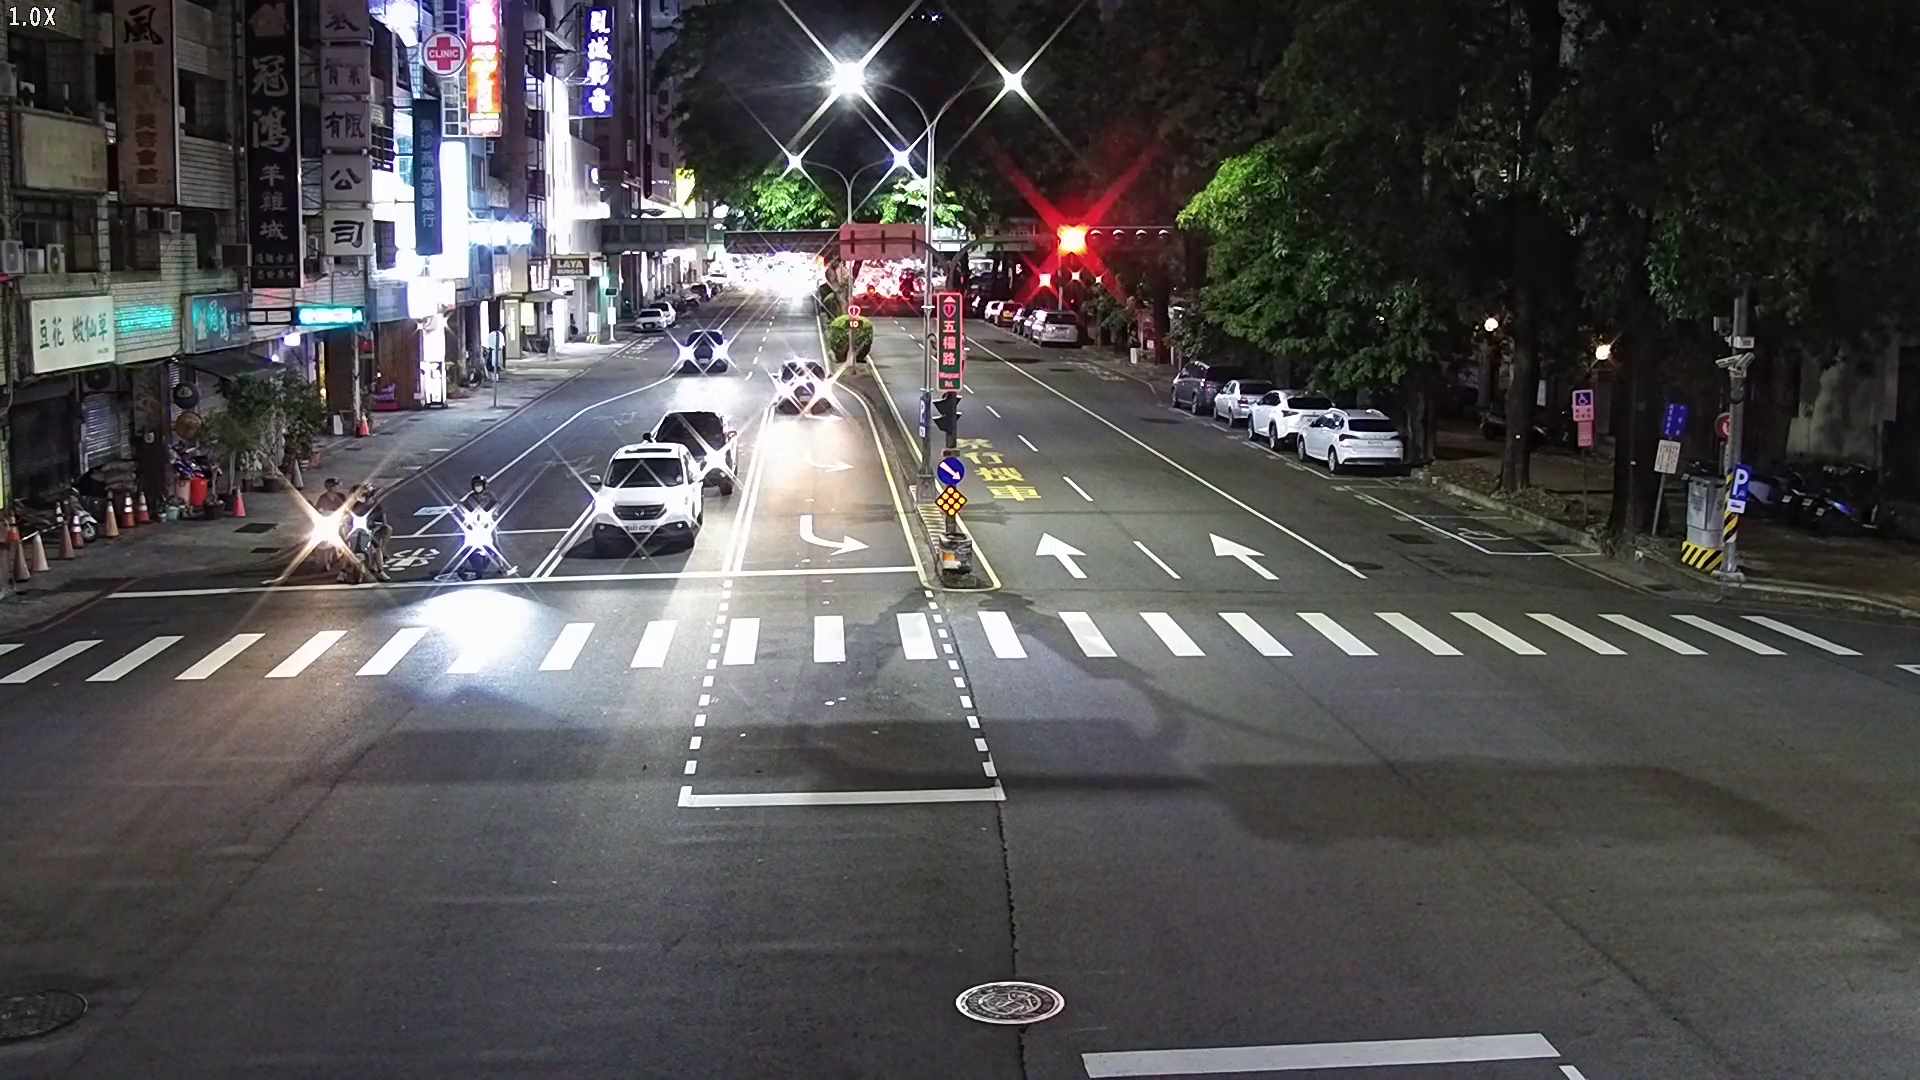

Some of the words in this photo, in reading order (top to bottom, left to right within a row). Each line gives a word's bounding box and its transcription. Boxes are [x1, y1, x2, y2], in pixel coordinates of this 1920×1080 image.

[428, 49, 459, 58] CLINIC
[556, 259, 585, 268] LAYA
[1732, 468, 1749, 495] P
